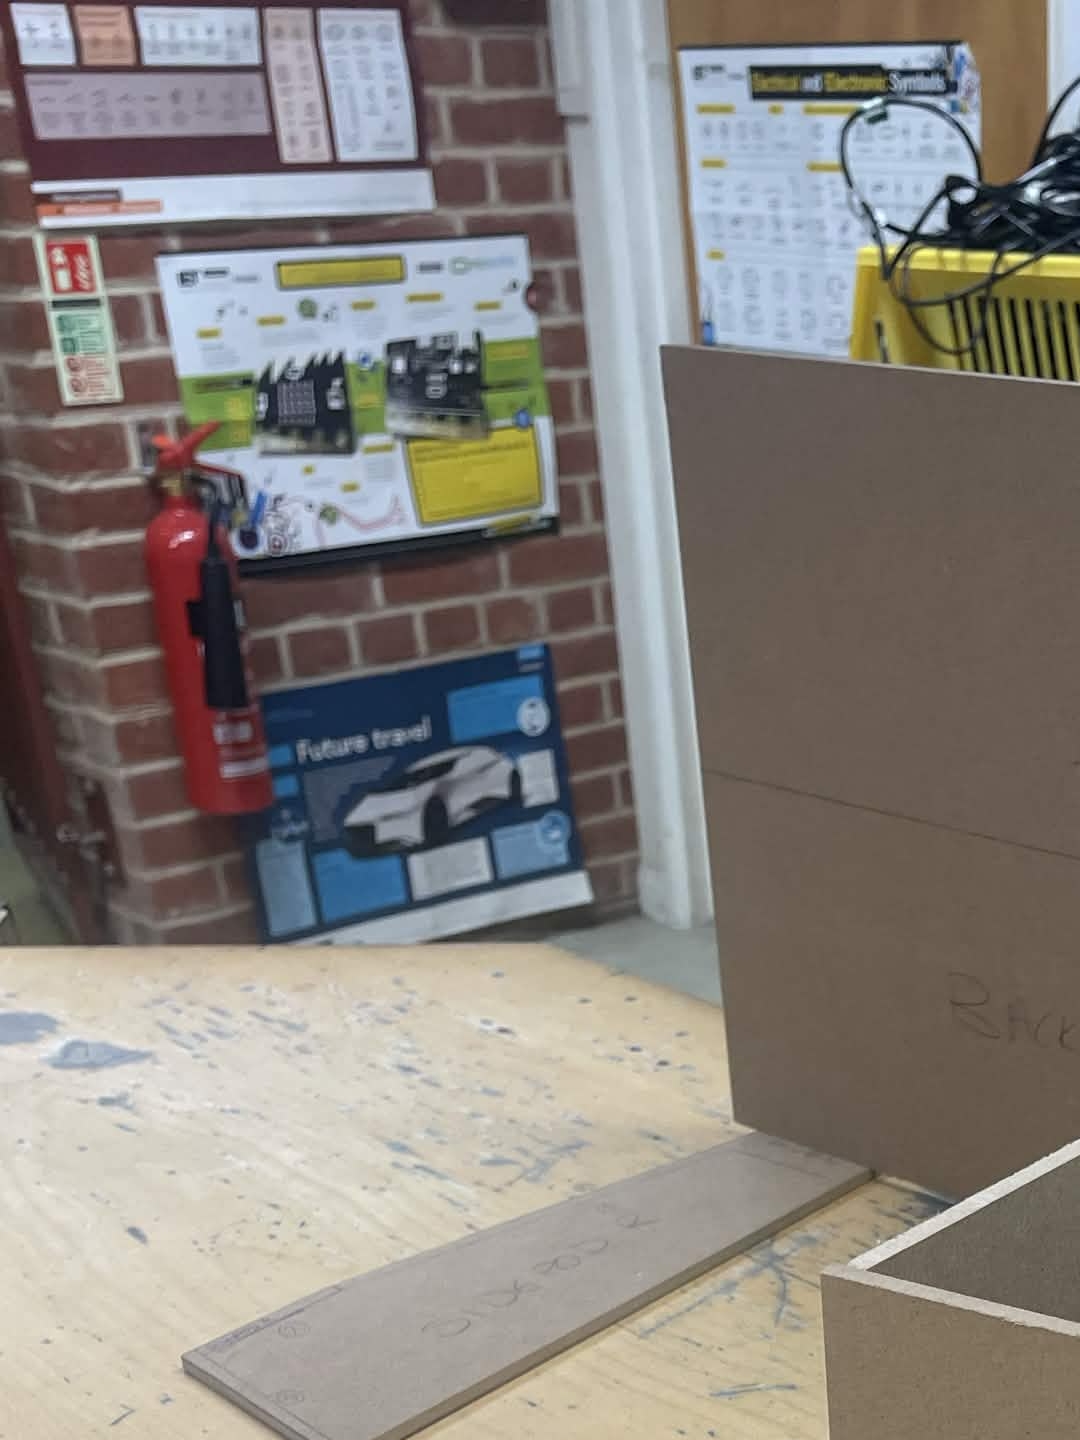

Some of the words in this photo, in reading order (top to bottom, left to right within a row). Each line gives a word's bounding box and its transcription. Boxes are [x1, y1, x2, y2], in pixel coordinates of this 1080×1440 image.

[888, 71, 946, 96] Symbols
[296, 733, 369, 764] Future
[371, 715, 432, 750] travel
